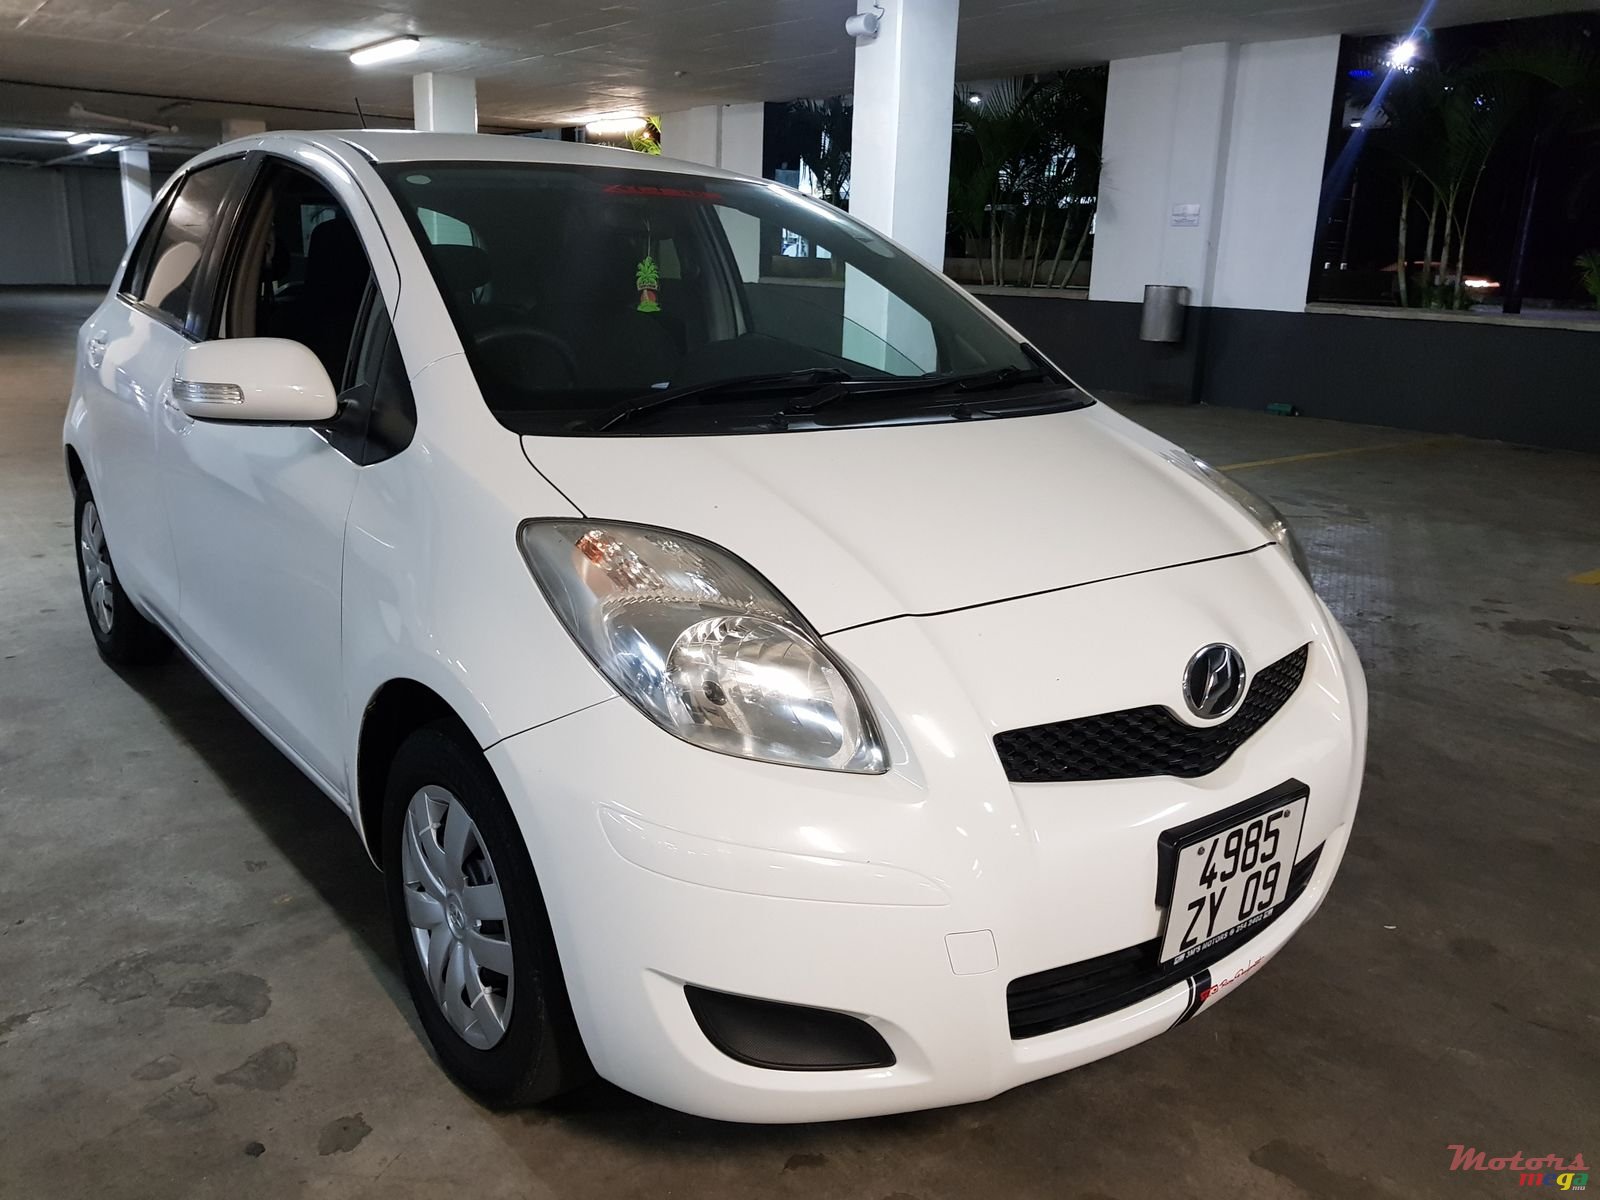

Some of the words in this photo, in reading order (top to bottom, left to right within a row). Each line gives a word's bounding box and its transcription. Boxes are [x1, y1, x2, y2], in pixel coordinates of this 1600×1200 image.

[1199, 810, 1283, 889] 4985
[1180, 886, 1227, 952] ZY
[1238, 862, 1281, 921] 09
[1202, 932, 1228, 950] MOTORS
